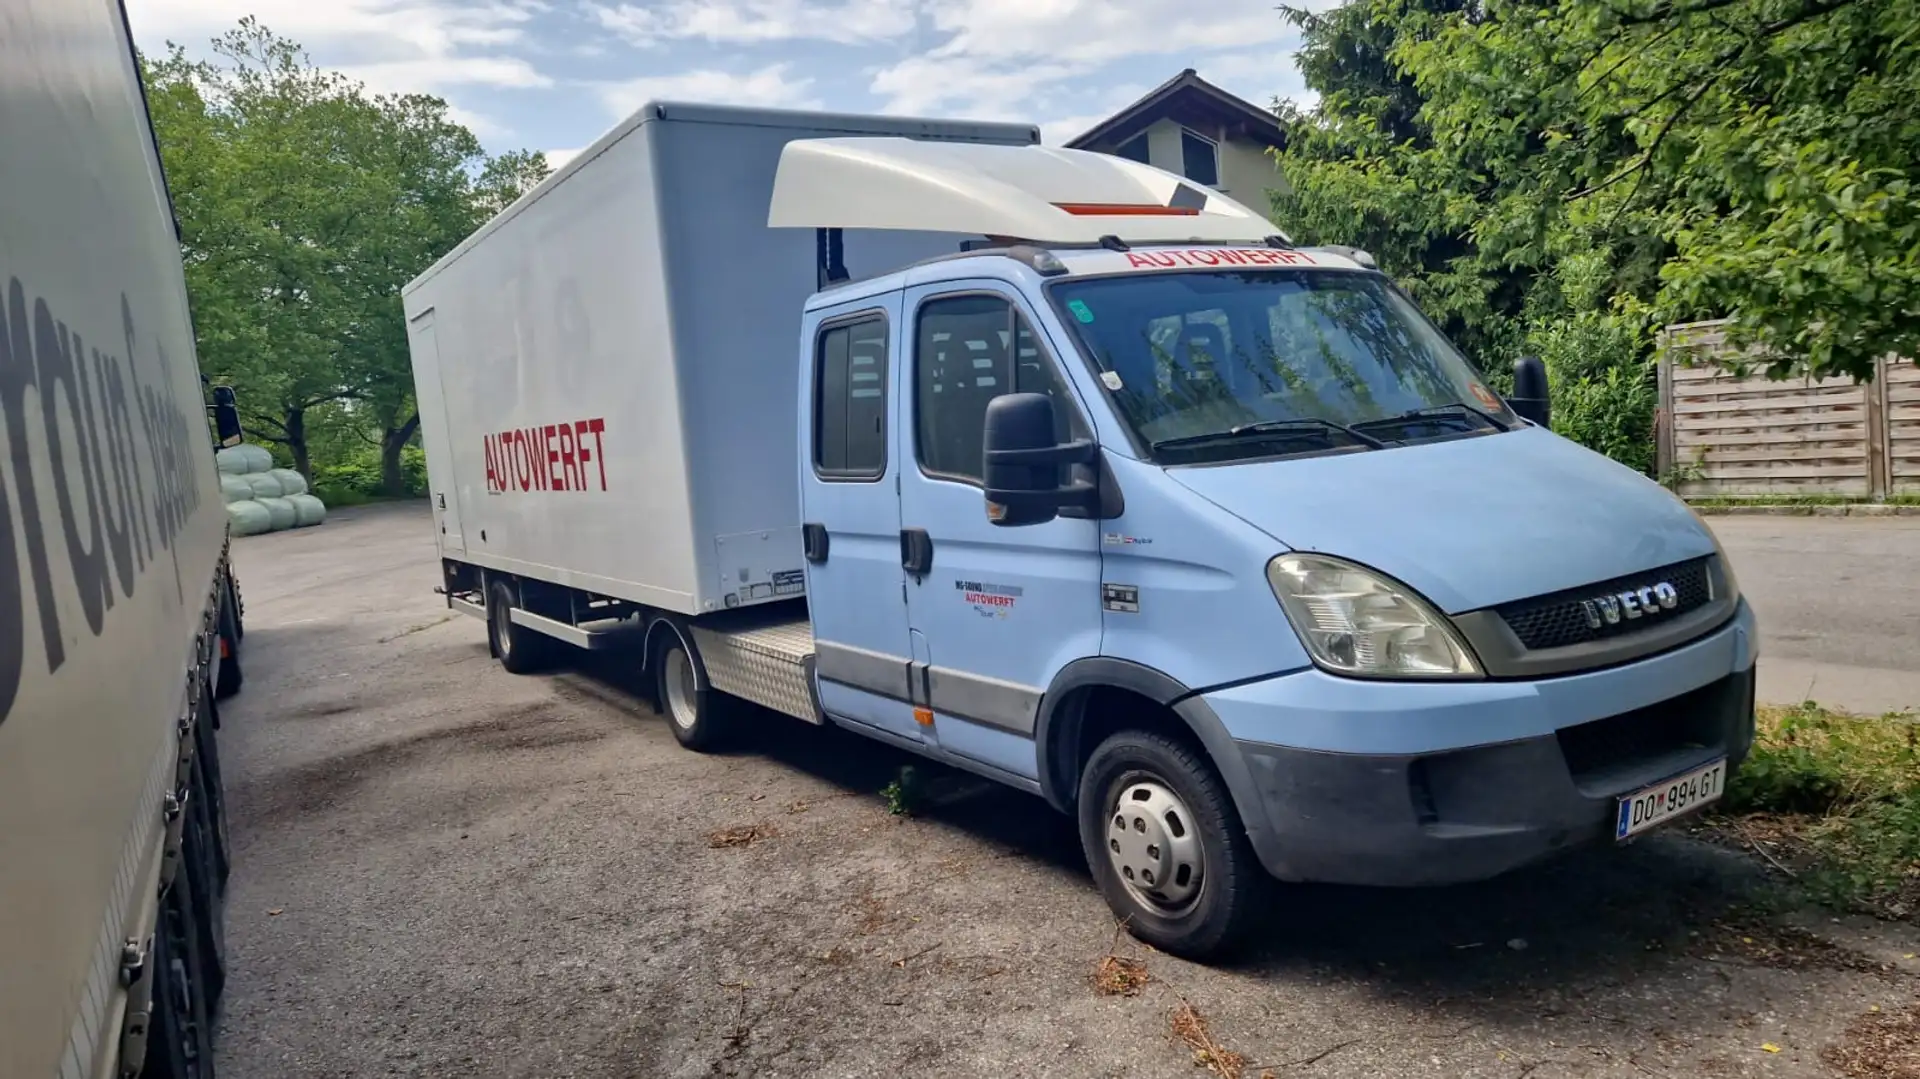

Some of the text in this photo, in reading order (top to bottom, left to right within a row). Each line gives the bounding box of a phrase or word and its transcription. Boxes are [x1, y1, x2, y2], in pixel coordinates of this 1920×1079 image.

[1126, 250, 1317, 267] AUTOWERFT
[484, 418, 607, 492] AUTOWERFT
[0, 276, 153, 726] raun
[965, 592, 1015, 608] AUTOWERFT
[1582, 581, 1678, 629] IVECO
[1632, 794, 1656, 826] DO
